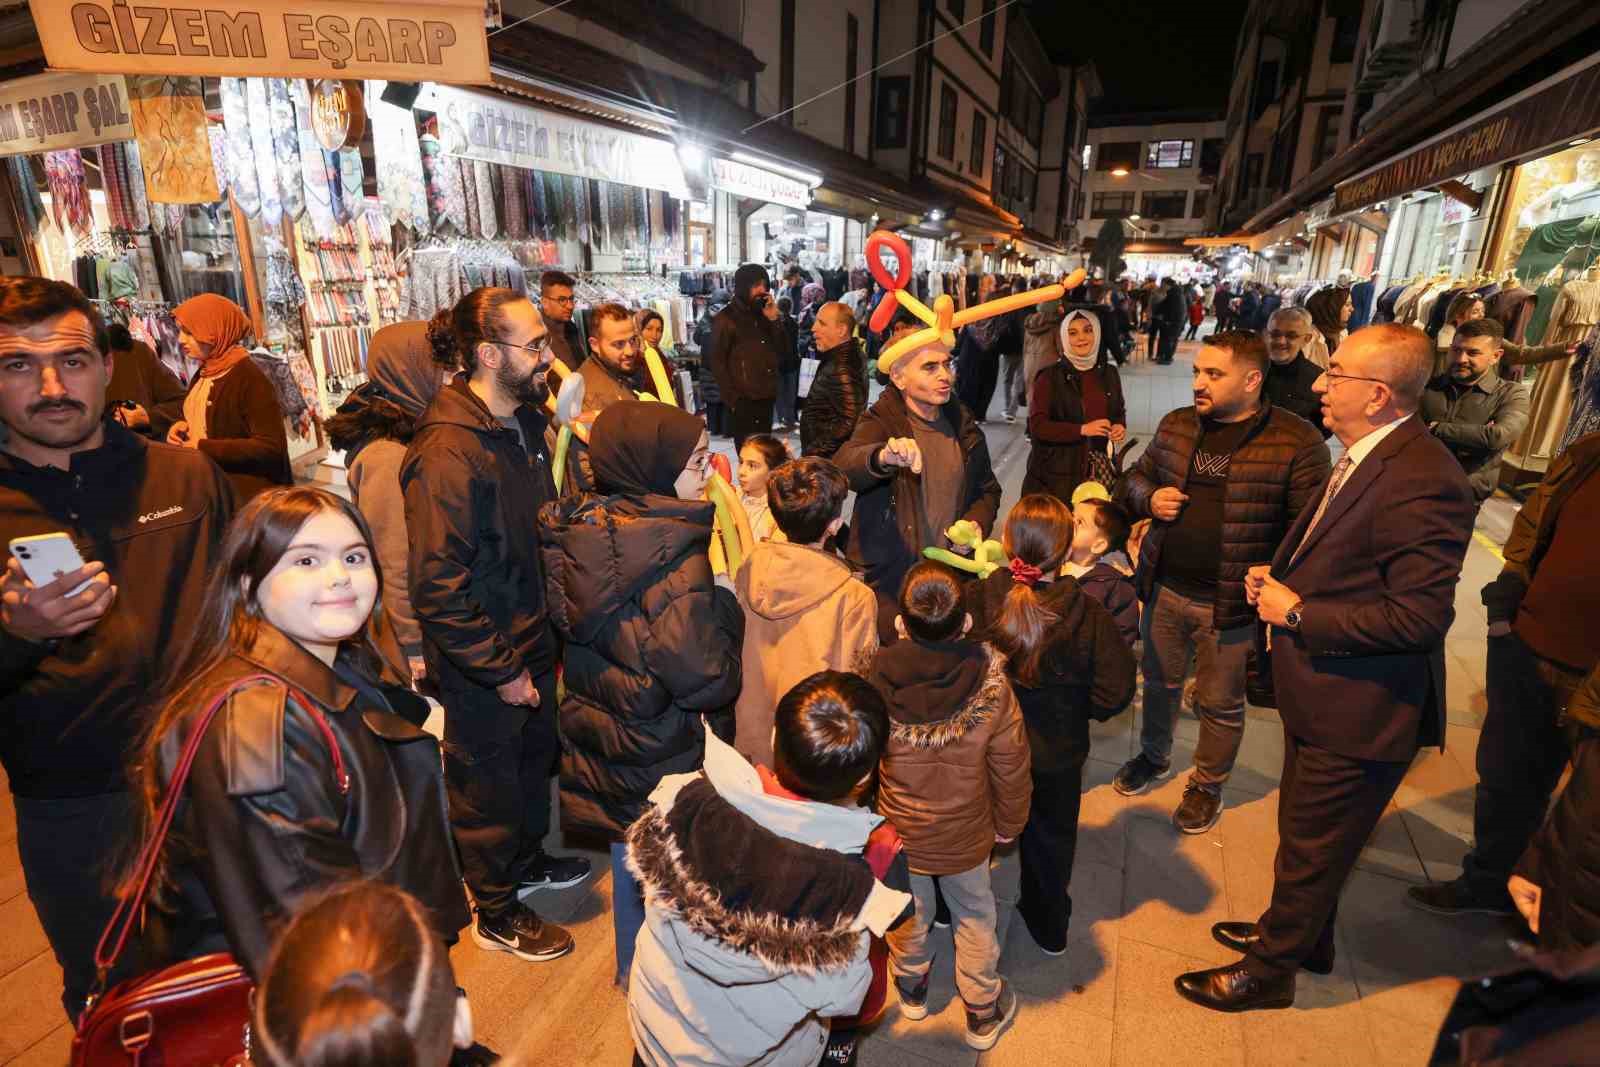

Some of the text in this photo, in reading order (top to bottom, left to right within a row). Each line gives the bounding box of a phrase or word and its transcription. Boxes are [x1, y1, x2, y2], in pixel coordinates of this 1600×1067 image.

[71, 0, 457, 69] GİZEM EŞARP
[17, 91, 79, 143] EŞARP
[83, 82, 129, 136] ŞAL
[146, 504, 183, 521] Columbia
